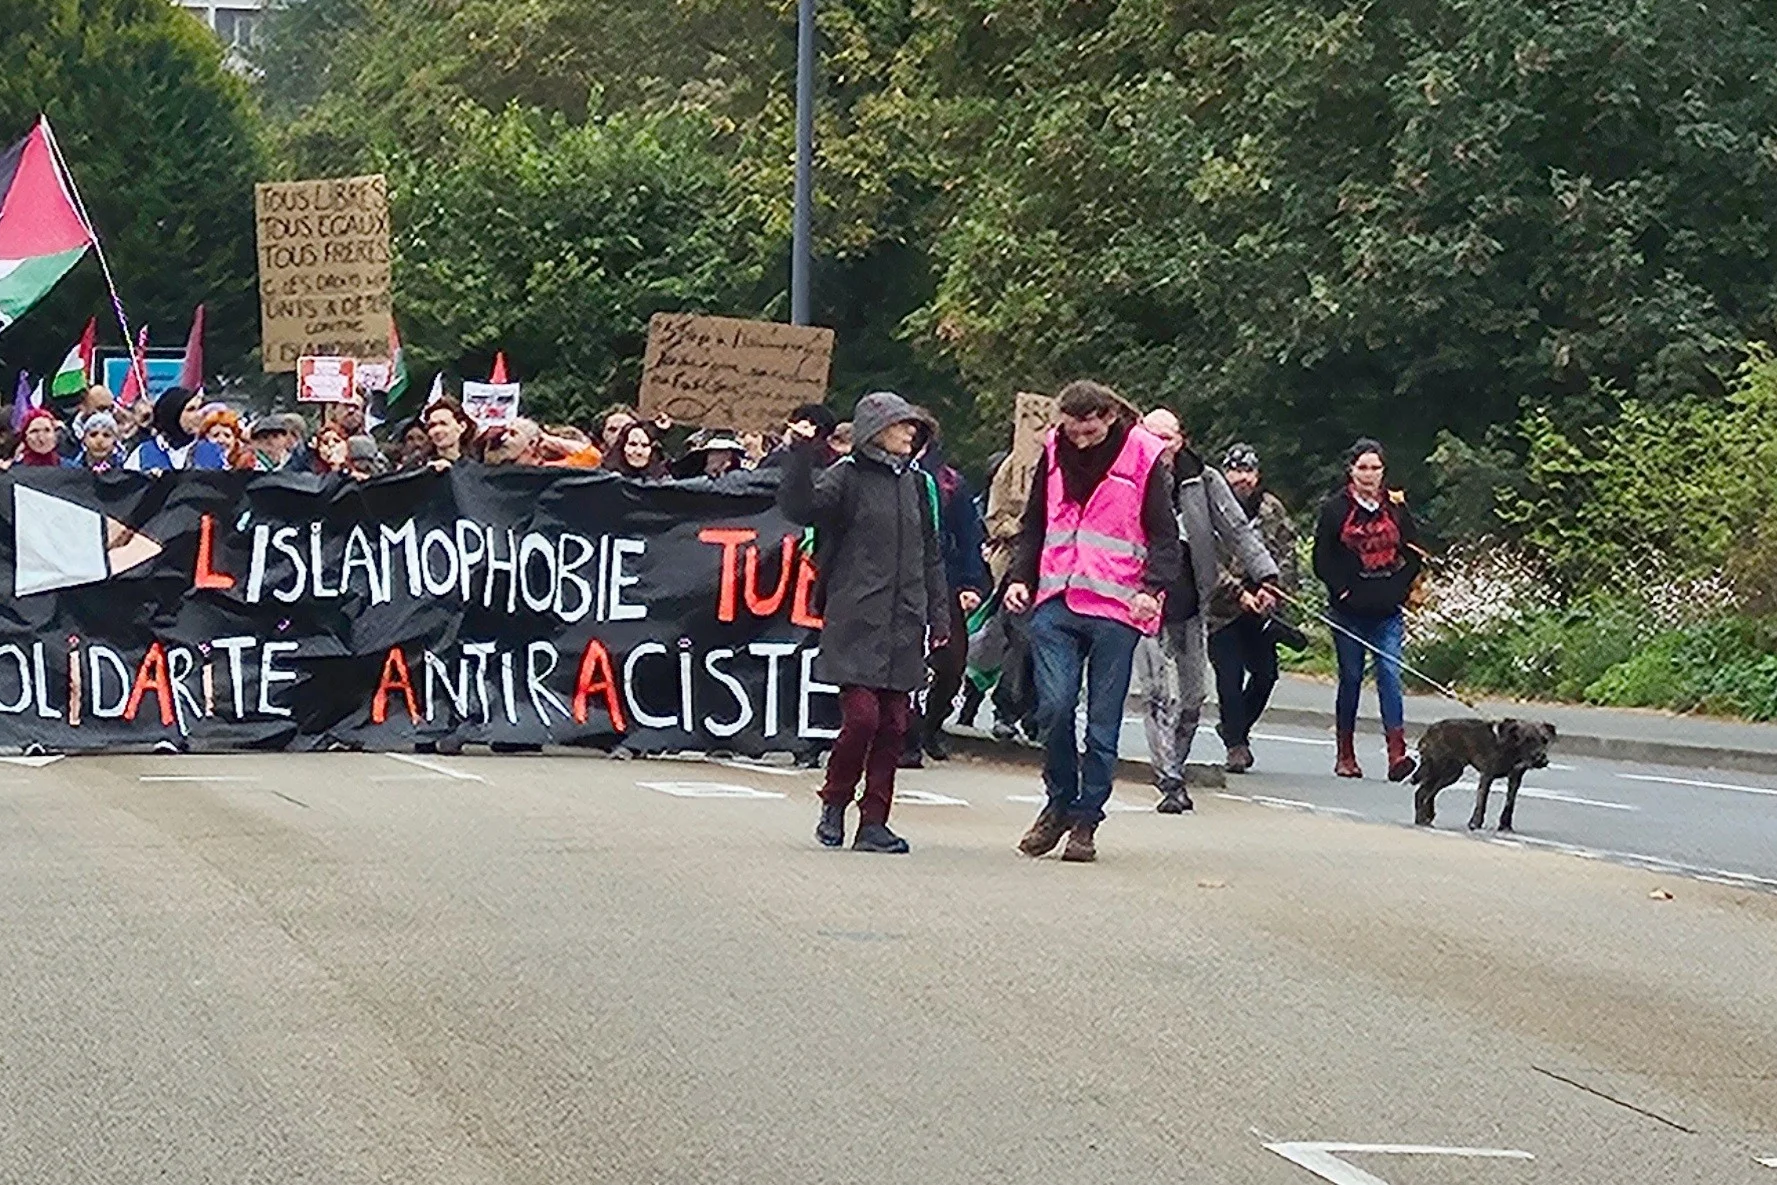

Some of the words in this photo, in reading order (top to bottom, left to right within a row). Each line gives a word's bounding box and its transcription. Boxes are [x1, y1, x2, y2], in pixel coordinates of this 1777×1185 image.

[261, 187, 309, 212] TOUS
[260, 215, 313, 240] TOUS
[261, 243, 318, 268] TOUS
[194, 512, 648, 623] L'ISLAMOPHOBIE
